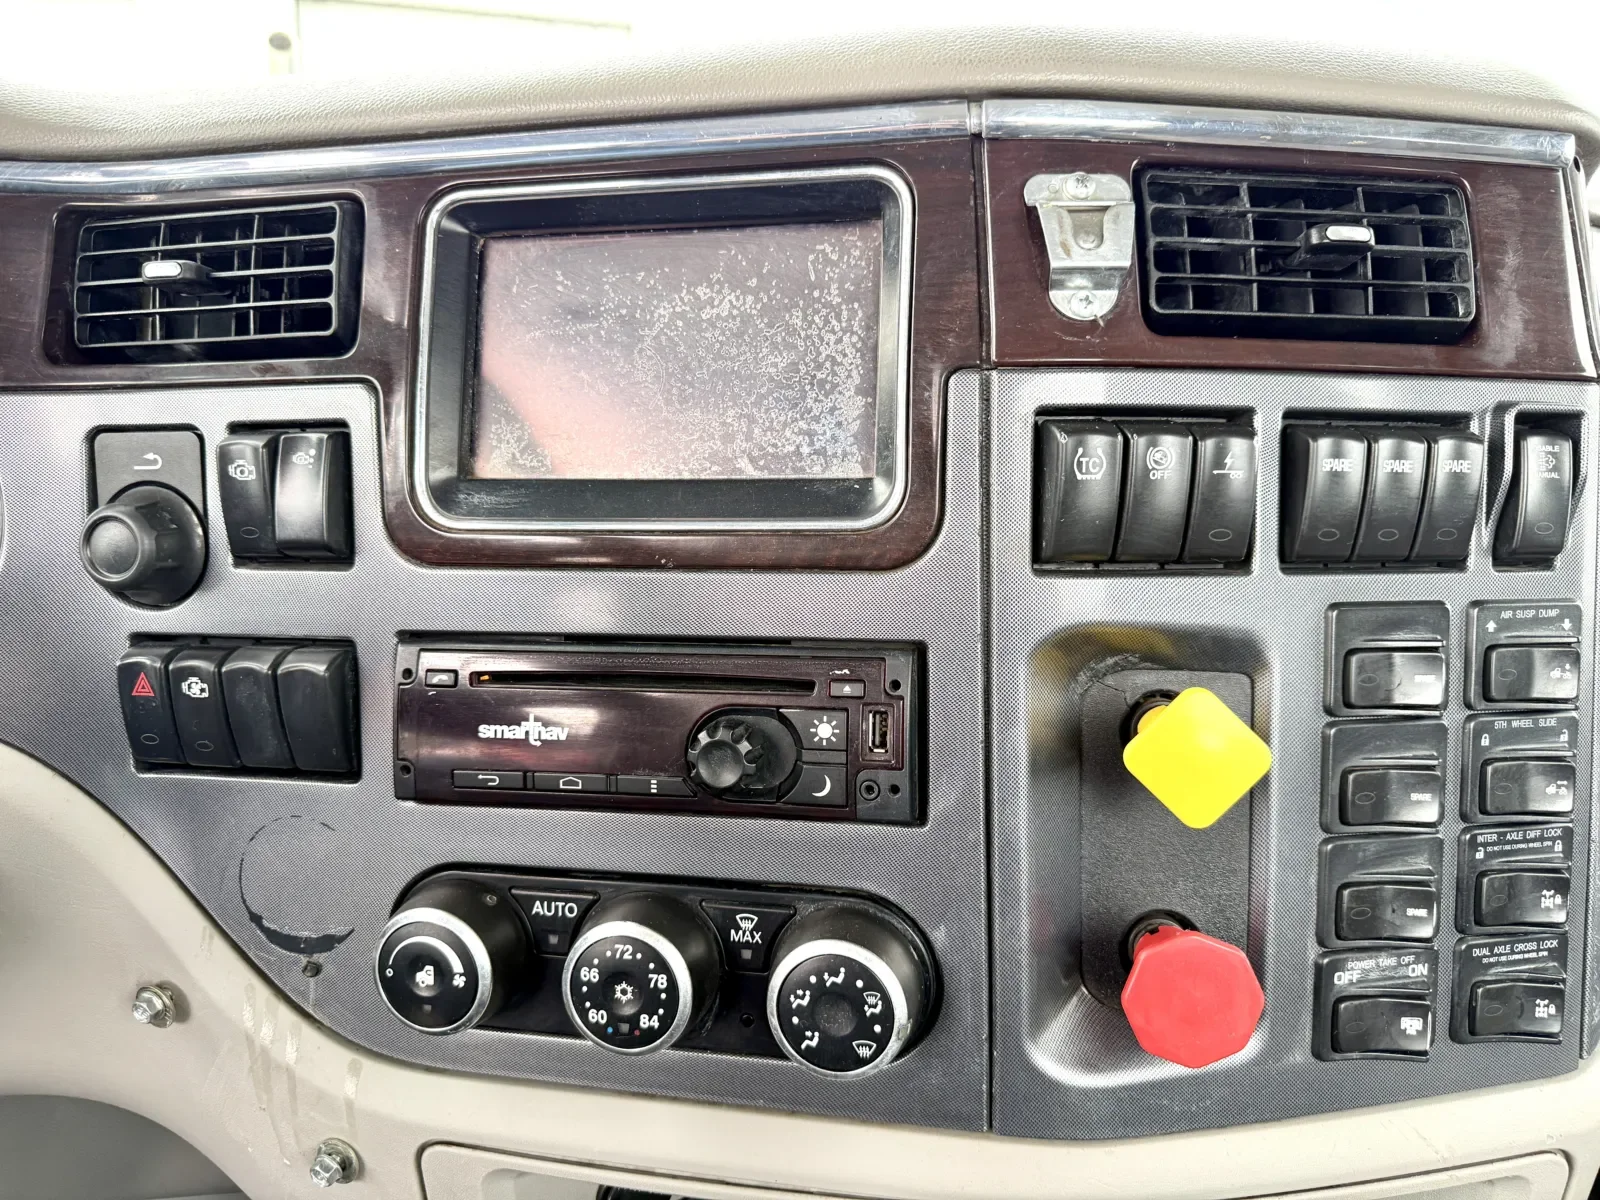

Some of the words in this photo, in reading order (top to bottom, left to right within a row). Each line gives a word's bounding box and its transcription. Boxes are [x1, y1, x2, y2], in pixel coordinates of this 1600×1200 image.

[1079, 457, 1100, 473] TC
[1322, 458, 1353, 472] SPARE
[1383, 459, 1414, 473] SPARE
[1442, 459, 1472, 473] SPARE
[1149, 469, 1173, 480] OFF
[1534, 471, 1561, 479] ANUAL
[1500, 610, 1513, 619] AIR
[1515, 609, 1536, 619] SUSP
[1538, 608, 1560, 618] DUMP
[477, 713, 569, 747] smartnav
[1494, 720, 1507, 730] 5TH
[1511, 719, 1535, 729] WHEEL
[1538, 718, 1557, 727] SLIDE
[1476, 833, 1498, 844] INTER
[1505, 831, 1524, 841] AXLE
[1526, 829, 1541, 839] DIFF
[1543, 828, 1563, 838] LOCK
[531, 900, 578, 918] AUTO
[730, 929, 762, 944] MAX
[614, 944, 633, 960] 72
[1472, 946, 1491, 957] DUAL
[1493, 944, 1511, 954] AXLE
[1513, 941, 1537, 952] CROSS
[1540, 939, 1559, 949] LOCK
[1347, 960, 1376, 970] POWER
[1379, 956, 1398, 966] TAKE
[1400, 955, 1416, 965] OFF
[1408, 963, 1428, 977] ON
[580, 967, 599, 983] 66
[648, 974, 667, 989] 78
[1333, 969, 1361, 985] OFF
[588, 1009, 608, 1024] 60
[639, 1014, 660, 1029] 84
